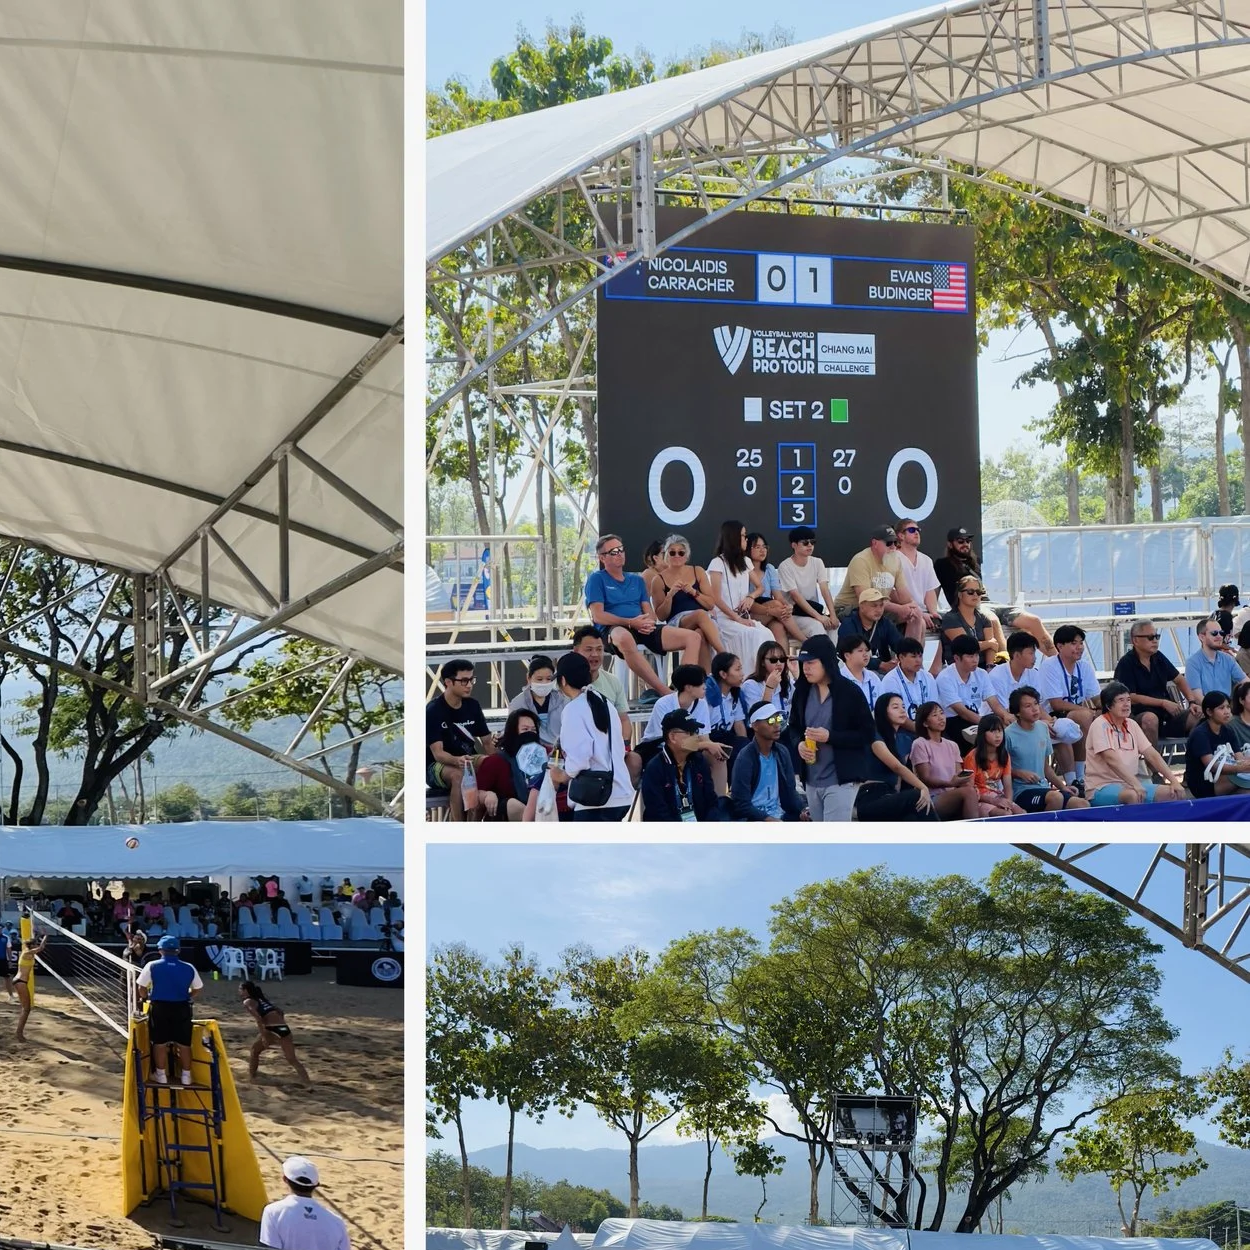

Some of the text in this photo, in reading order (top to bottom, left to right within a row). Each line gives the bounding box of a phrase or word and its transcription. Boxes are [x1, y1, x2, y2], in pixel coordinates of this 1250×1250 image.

[648, 258, 728, 274] NICOLAIDIS
[648, 276, 734, 292] CARRACHER
[766, 266, 818, 294] 0 1
[890, 270, 932, 284] EVANS
[868, 286, 932, 301] BUDINGER
[752, 330, 791, 338] VOLLEYBALL
[752, 338, 815, 359] BEACH
[821, 345, 872, 354] CHIANG MAI
[752, 359, 815, 374] PRO TOUR
[824, 364, 870, 373] CHALLENGE
[770, 400, 824, 419] SET 2
[736, 449, 856, 468] 25 1 27
[648, 446, 706, 526] 0
[743, 476, 852, 496] 0 2 0
[886, 447, 938, 522] 0
[792, 504, 806, 522] 3
